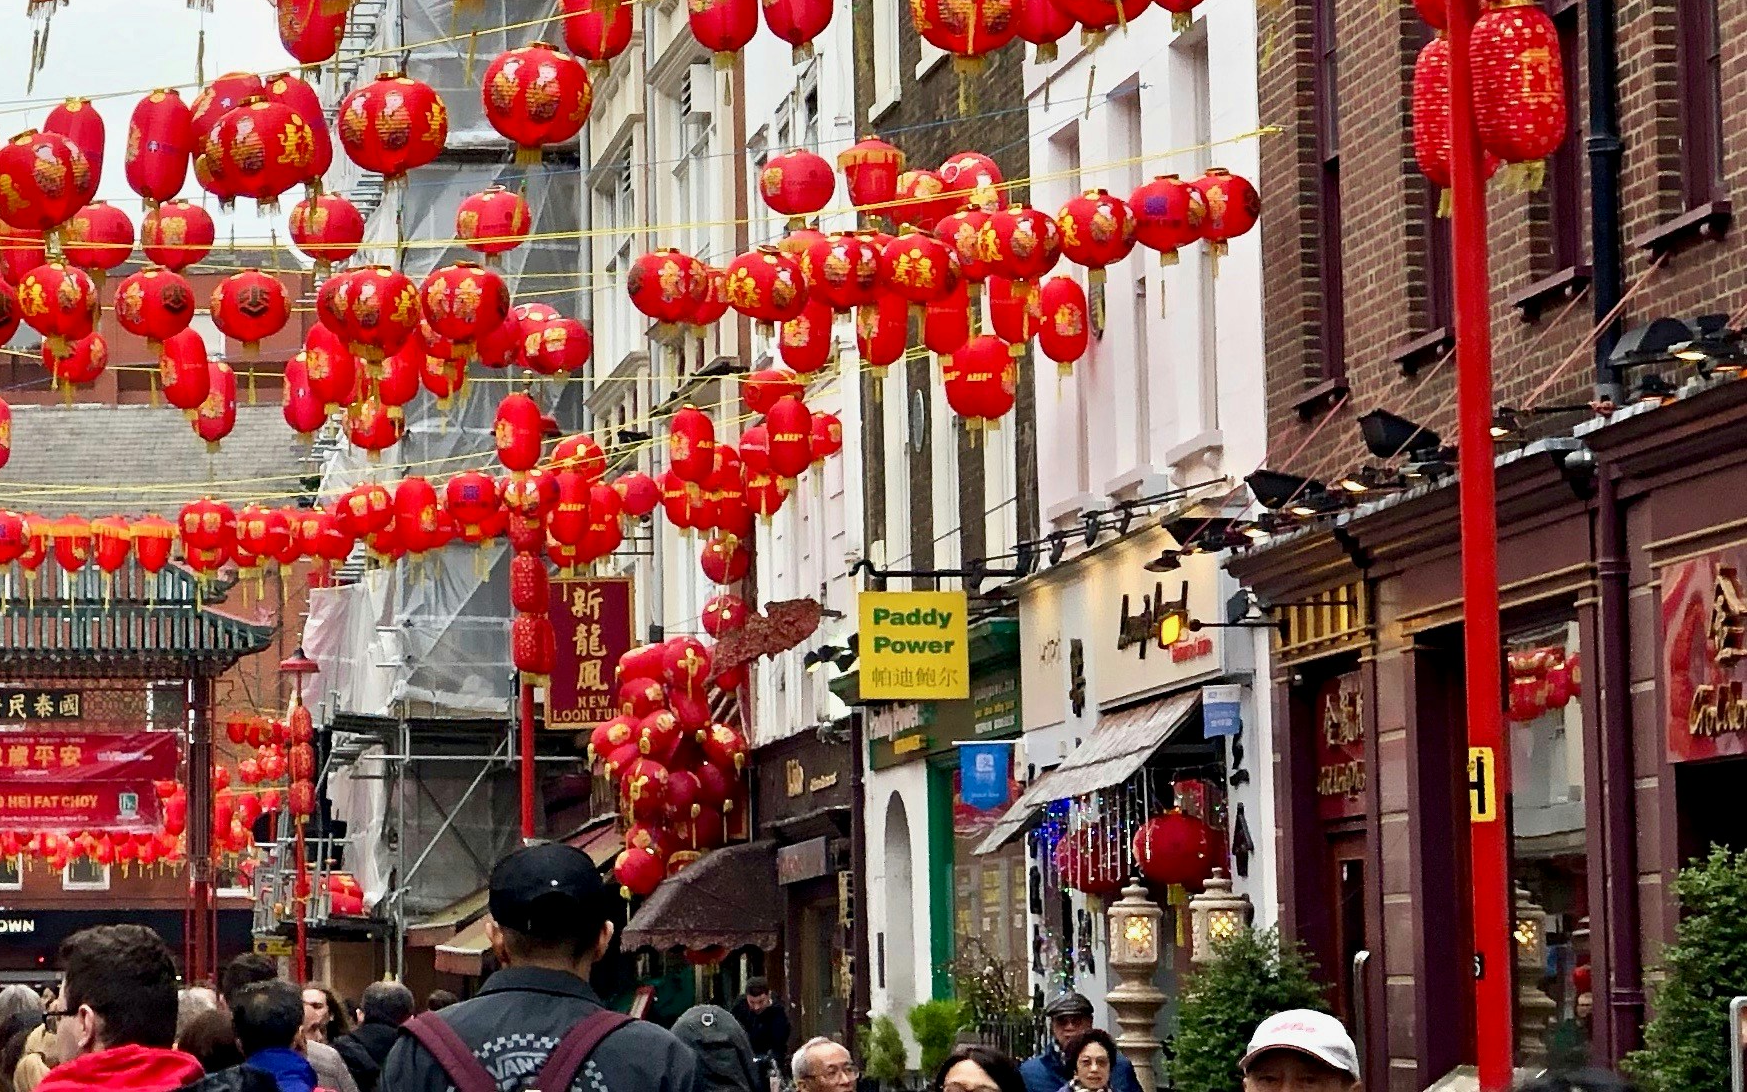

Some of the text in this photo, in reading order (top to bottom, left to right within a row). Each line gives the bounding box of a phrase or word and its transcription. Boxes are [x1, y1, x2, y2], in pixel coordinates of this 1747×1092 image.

[872, 607, 953, 629] Paddy
[571, 586, 609, 692] 新龍鳳
[873, 636, 955, 654] Power
[577, 695, 611, 708] NEW
[553, 708, 624, 722] LOON FUN
[7, 794, 32, 808] HEI
[34, 794, 59, 808] FAT
[61, 794, 99, 808] CHOY
